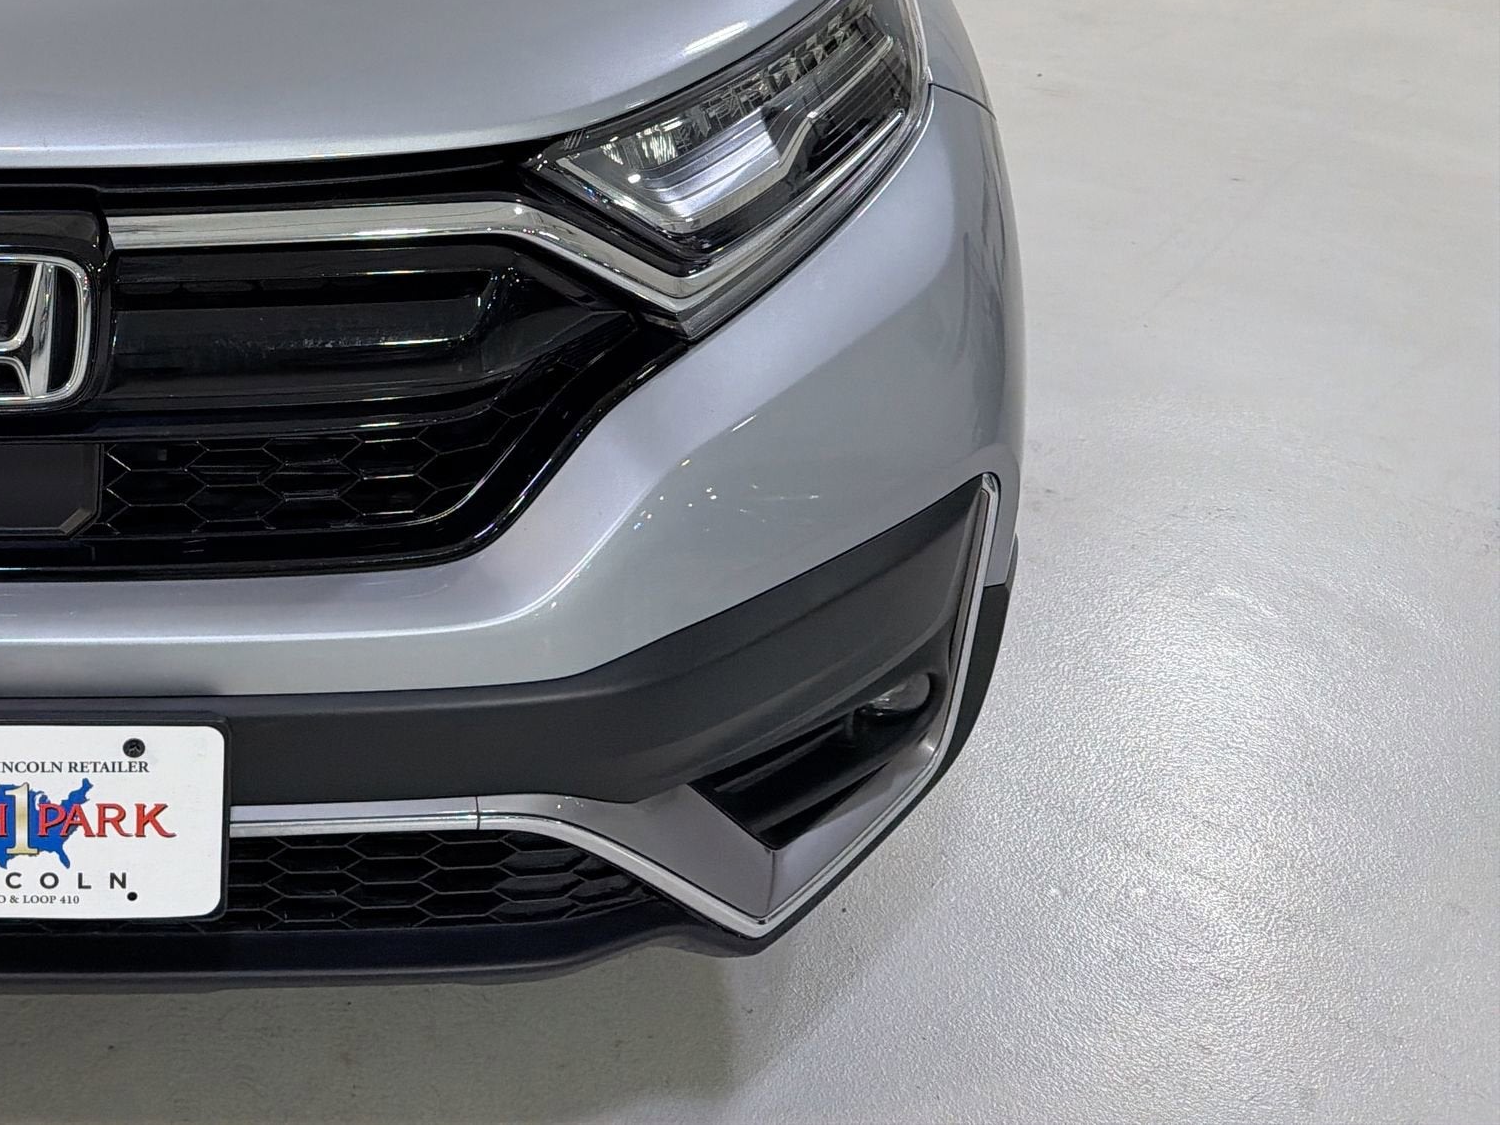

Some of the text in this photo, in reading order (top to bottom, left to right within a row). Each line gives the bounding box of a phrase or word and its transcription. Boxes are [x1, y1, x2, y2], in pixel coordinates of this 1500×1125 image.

[68, 761, 149, 773] RETAILER
[37, 803, 176, 838] PARK
[9, 895, 19, 904] &
[23, 894, 56, 904] LOOP
[59, 894, 79, 904] 410
